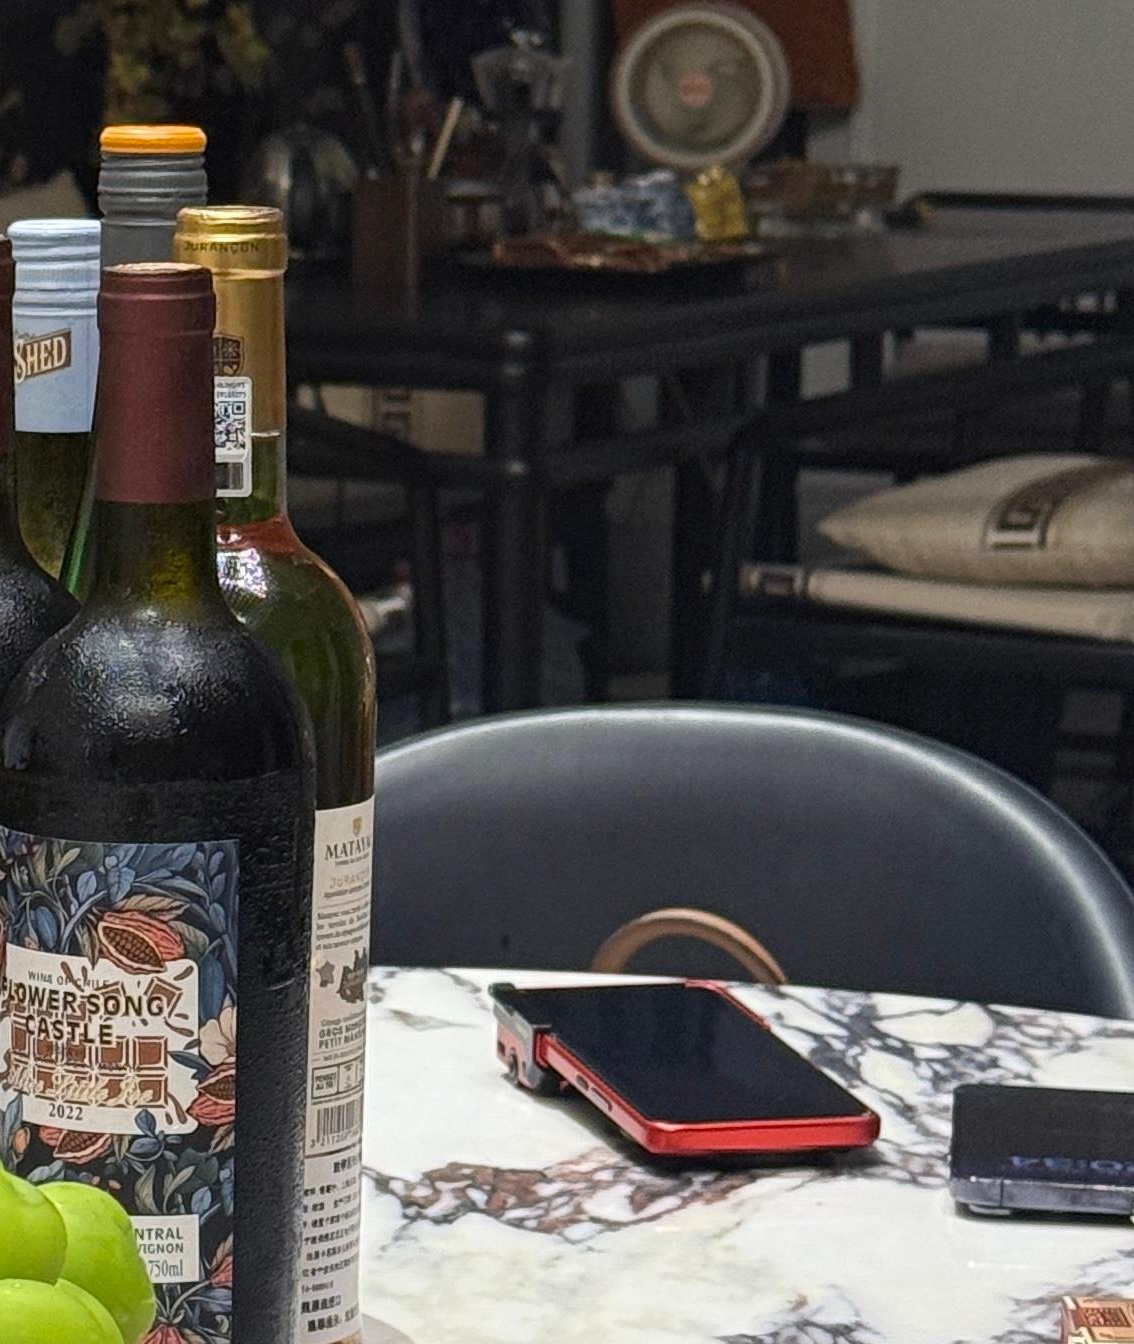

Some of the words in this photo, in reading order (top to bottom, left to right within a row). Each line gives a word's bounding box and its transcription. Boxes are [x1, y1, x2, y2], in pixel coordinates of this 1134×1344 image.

[14, 336, 67, 384] SHED
[28, 970, 53, 985] WINE
[2, 976, 78, 1014] FLOWER
[86, 993, 165, 1018] SONG
[25, 1014, 114, 1046] CASTLE
[48, 1102, 84, 1121] 2022
[134, 1227, 184, 1241] NTRAL
[148, 1258, 184, 1278] 750ml
